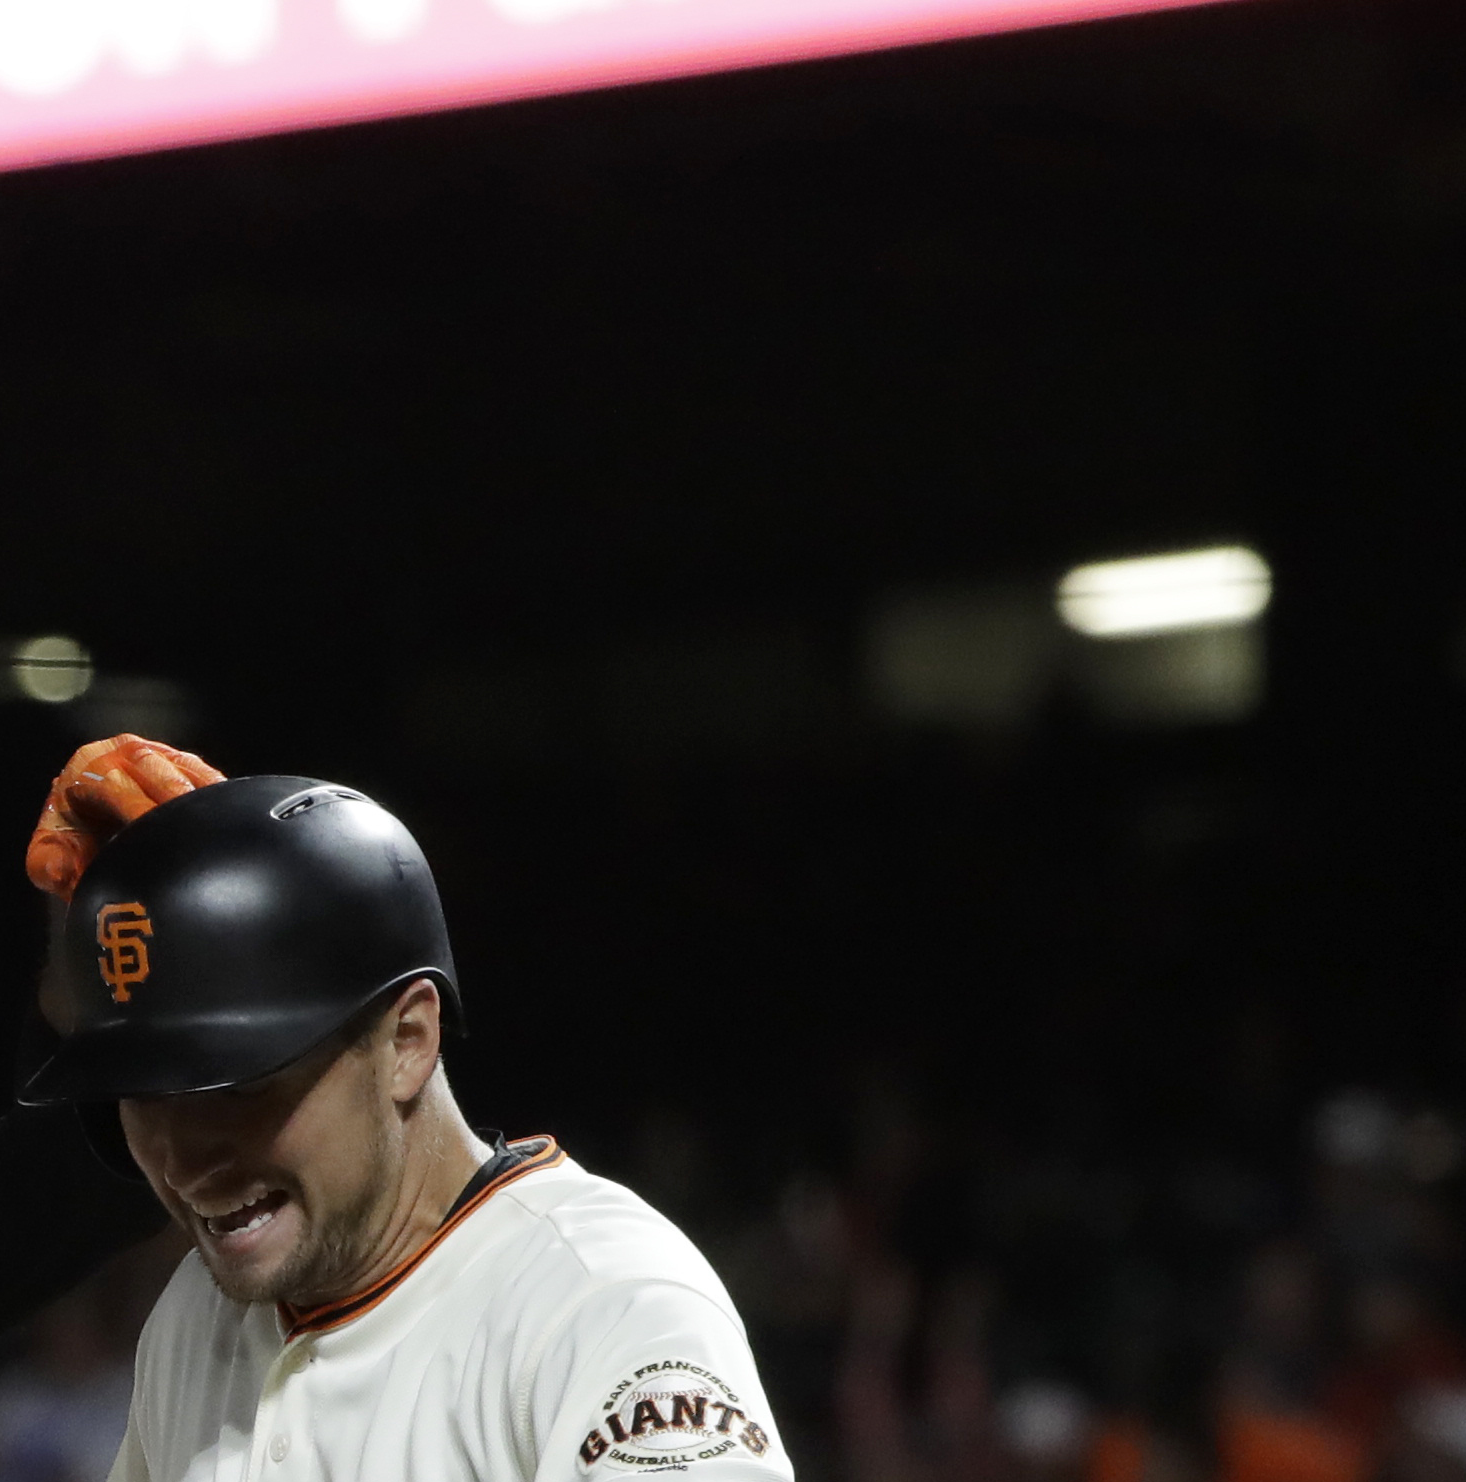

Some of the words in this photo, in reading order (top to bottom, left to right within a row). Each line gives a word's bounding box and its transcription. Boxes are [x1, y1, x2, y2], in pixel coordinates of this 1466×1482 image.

[96, 901, 154, 1002] SF
[602, 1379, 632, 1412] SAN
[633, 1359, 741, 1404] FRANCISCO
[578, 1394, 772, 1466] GIANTS
[608, 1448, 696, 1466] BASEBALL
[698, 1439, 738, 1460] CLUB
